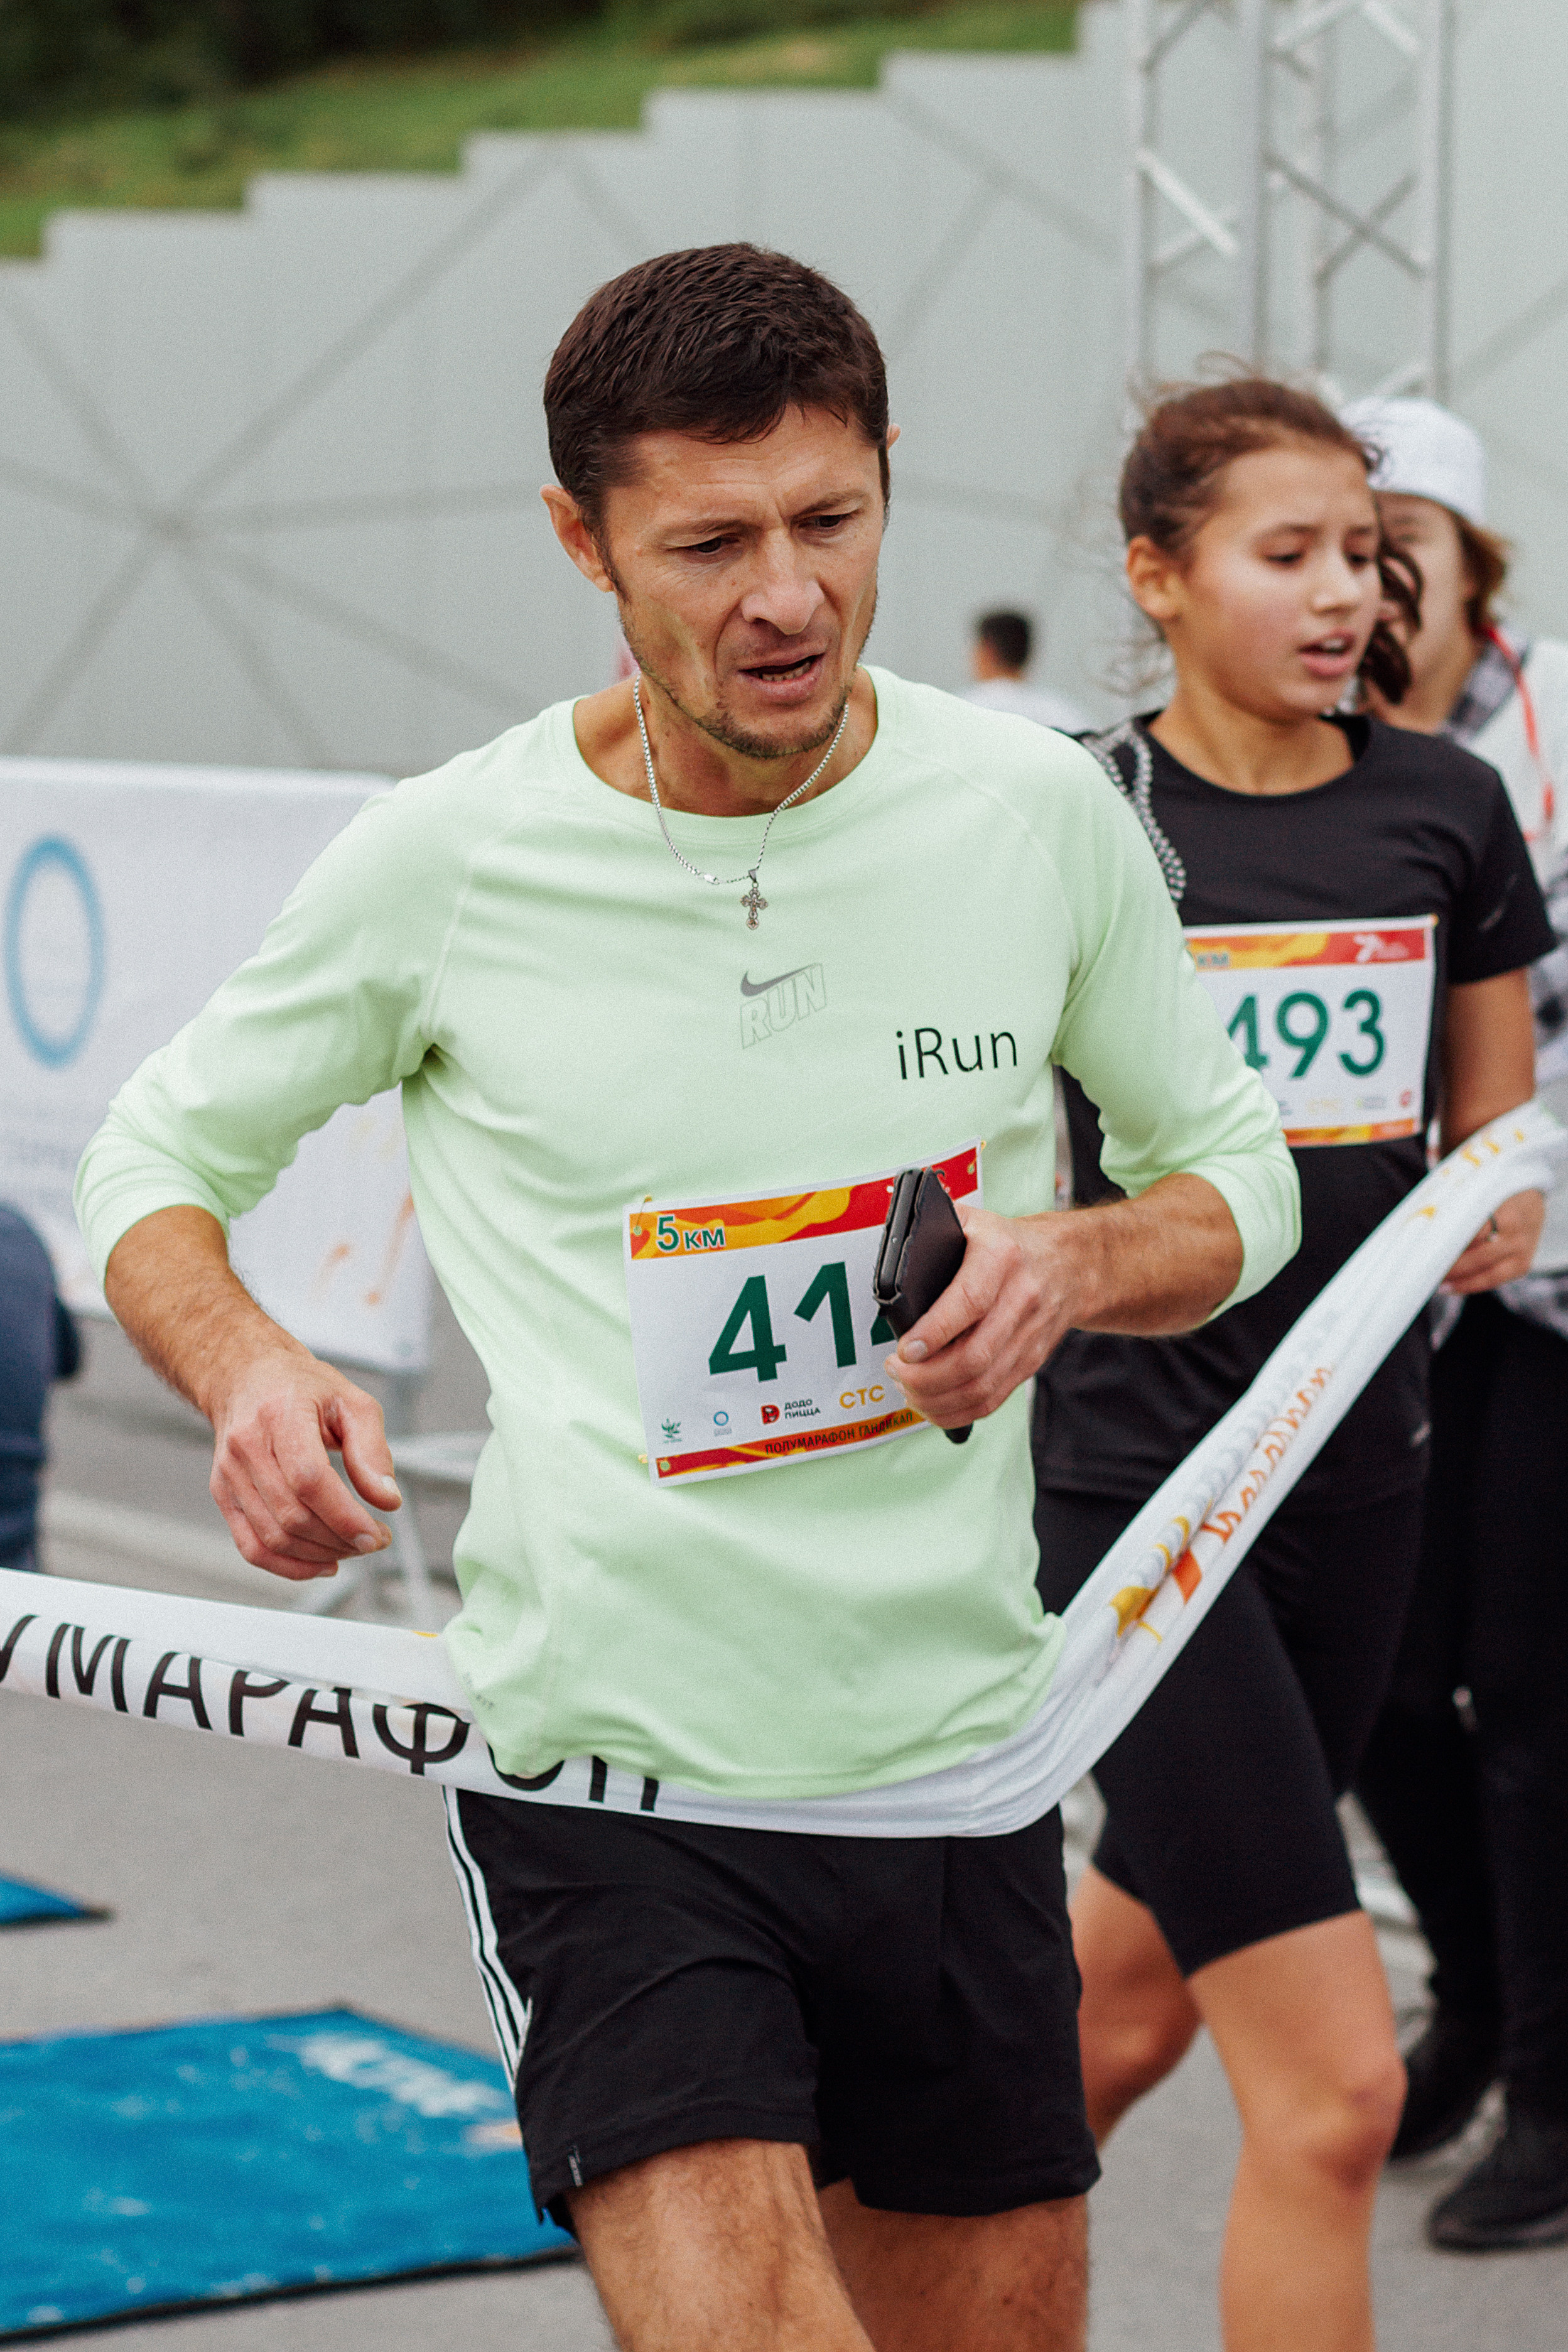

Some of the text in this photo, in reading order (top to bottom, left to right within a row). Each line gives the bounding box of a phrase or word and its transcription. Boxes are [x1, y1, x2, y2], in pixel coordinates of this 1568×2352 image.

[740, 962, 828, 1049] RUN
[895, 1027, 1018, 1080] iRun
[708, 1260, 898, 1382] 41
[838, 1384, 885, 1409] СТС
[765, 1411, 914, 1455] ПОЛУМАРАФОН ГАНДИКАП
